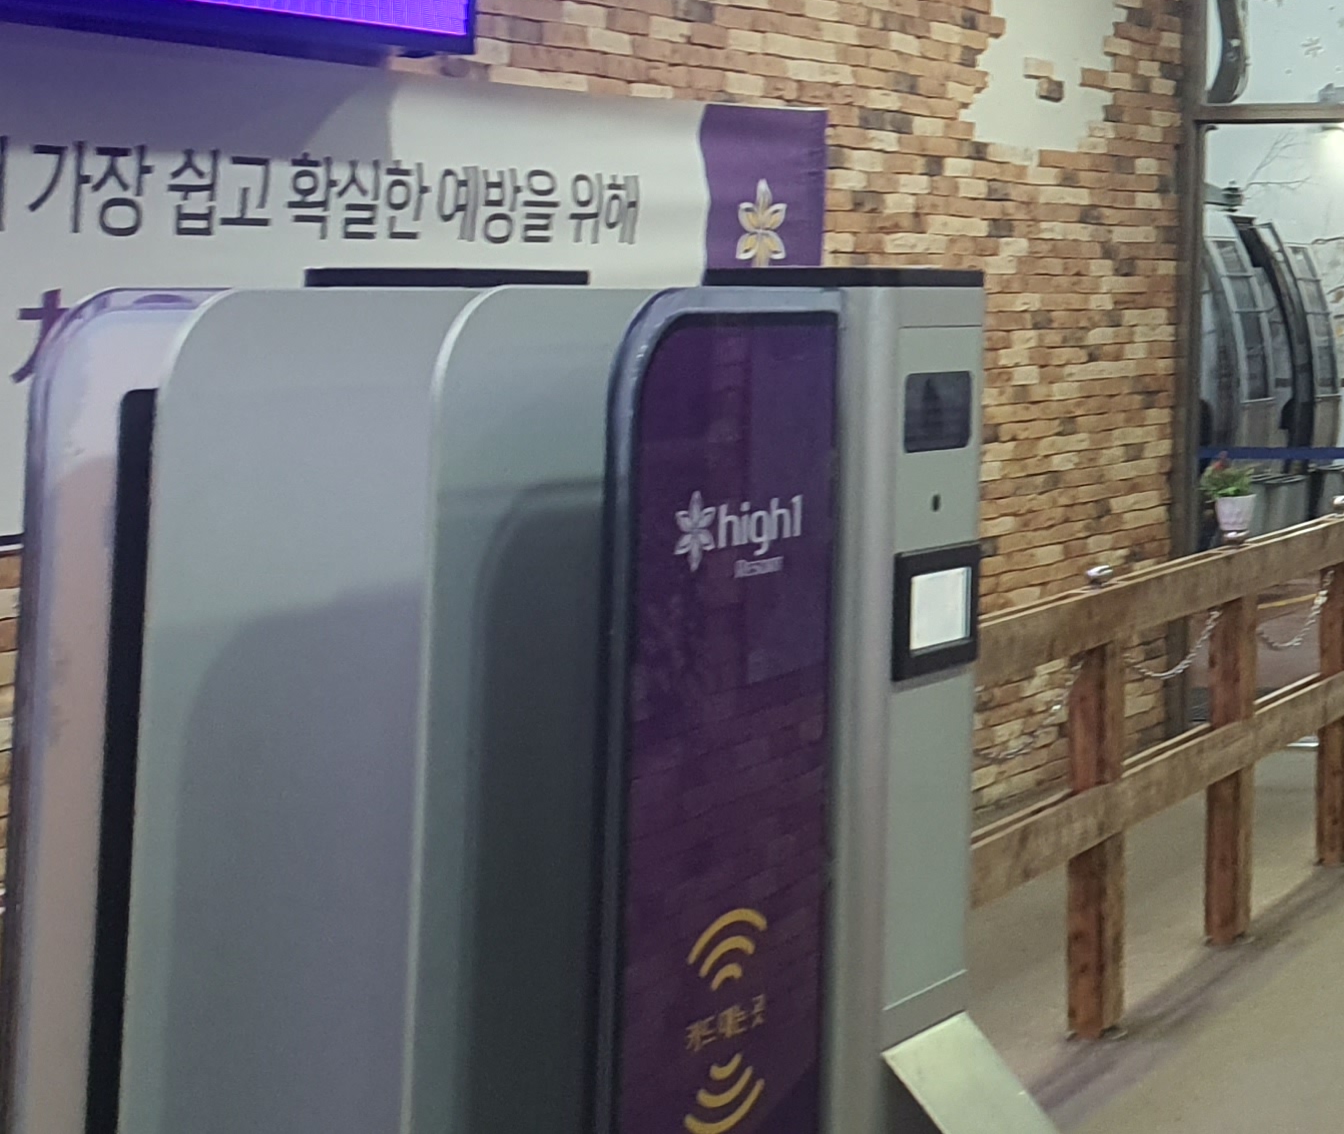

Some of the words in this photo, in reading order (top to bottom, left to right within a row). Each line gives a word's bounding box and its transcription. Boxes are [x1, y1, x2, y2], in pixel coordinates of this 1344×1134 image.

[28, 141, 152, 237] 가장
[167, 148, 272, 237] 쉽고
[287, 152, 431, 241] 확실한
[436, 165, 561, 244] 예방을
[568, 172, 640, 245] 위해
[717, 494, 803, 556] high1
